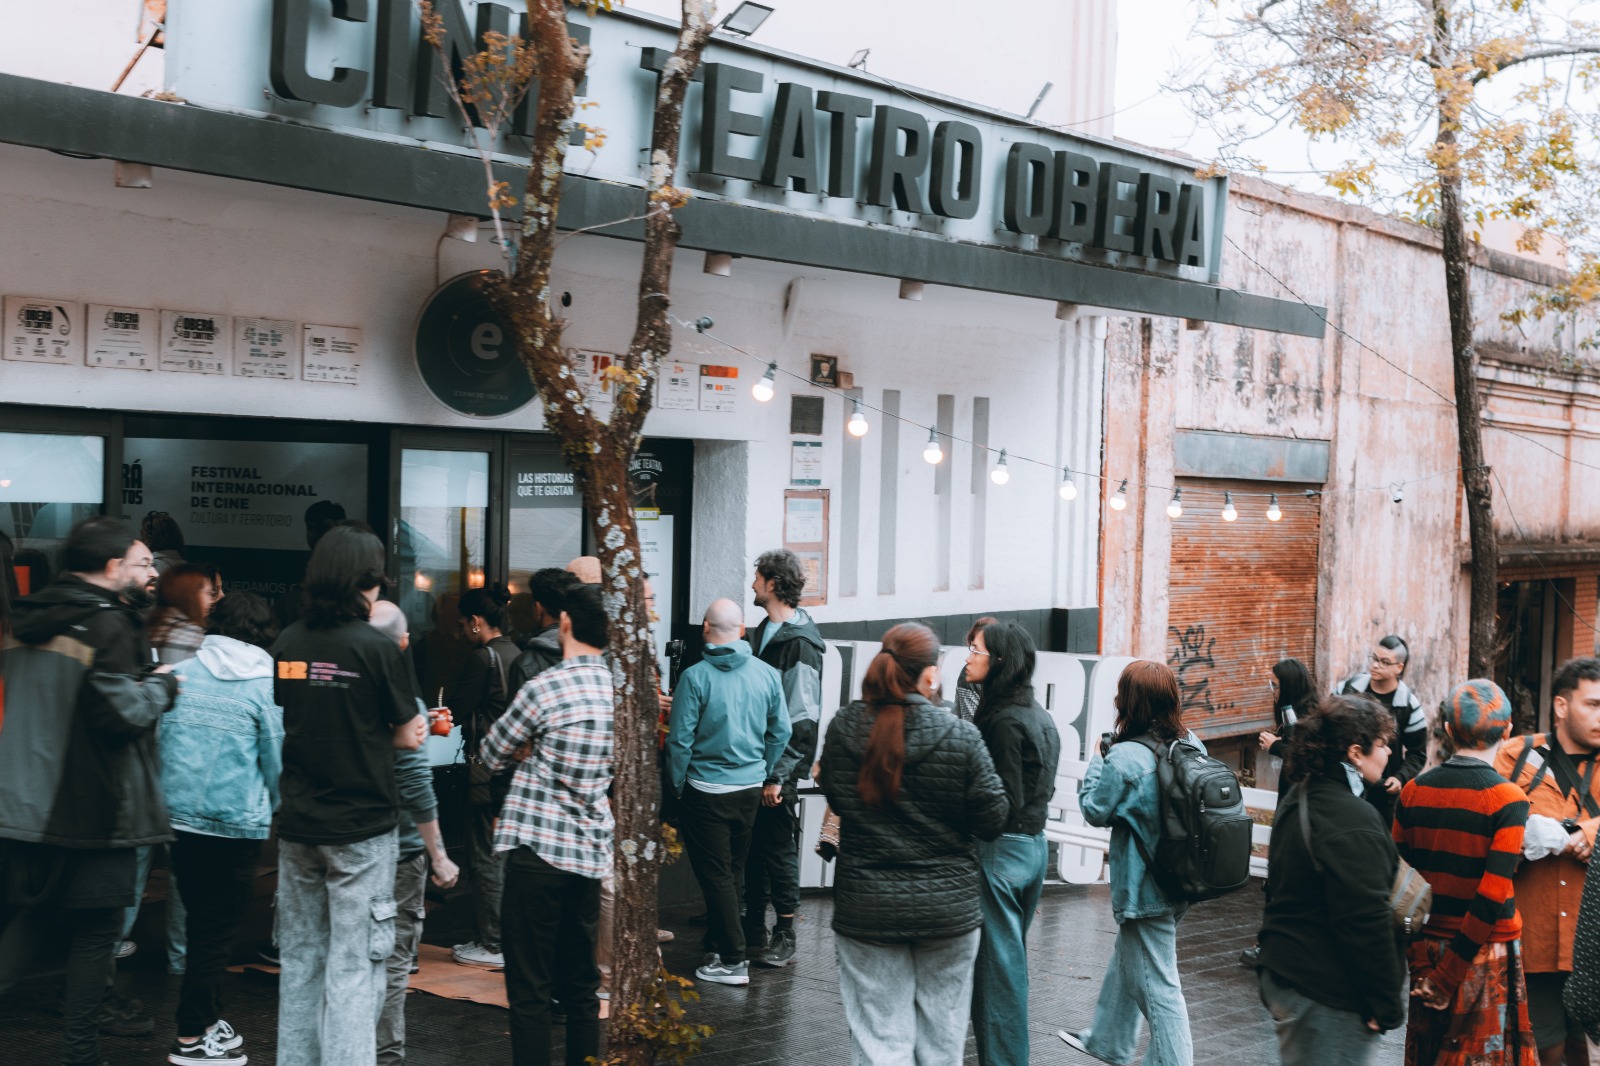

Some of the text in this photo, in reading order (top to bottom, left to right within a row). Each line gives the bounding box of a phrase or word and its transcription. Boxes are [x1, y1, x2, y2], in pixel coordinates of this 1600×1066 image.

[1004, 142, 1206, 267] OBERA
[191, 466, 261, 479] FESTIVAL
[518, 473, 574, 484] LAS HISTORIAS
[191, 481, 317, 497] INTERNACIONAL
[517, 485, 574, 497] QUE TE GUSTAN
[191, 497, 249, 510] DE CINE
[190, 511, 292, 527] CULTURA Y TERRITORIO
